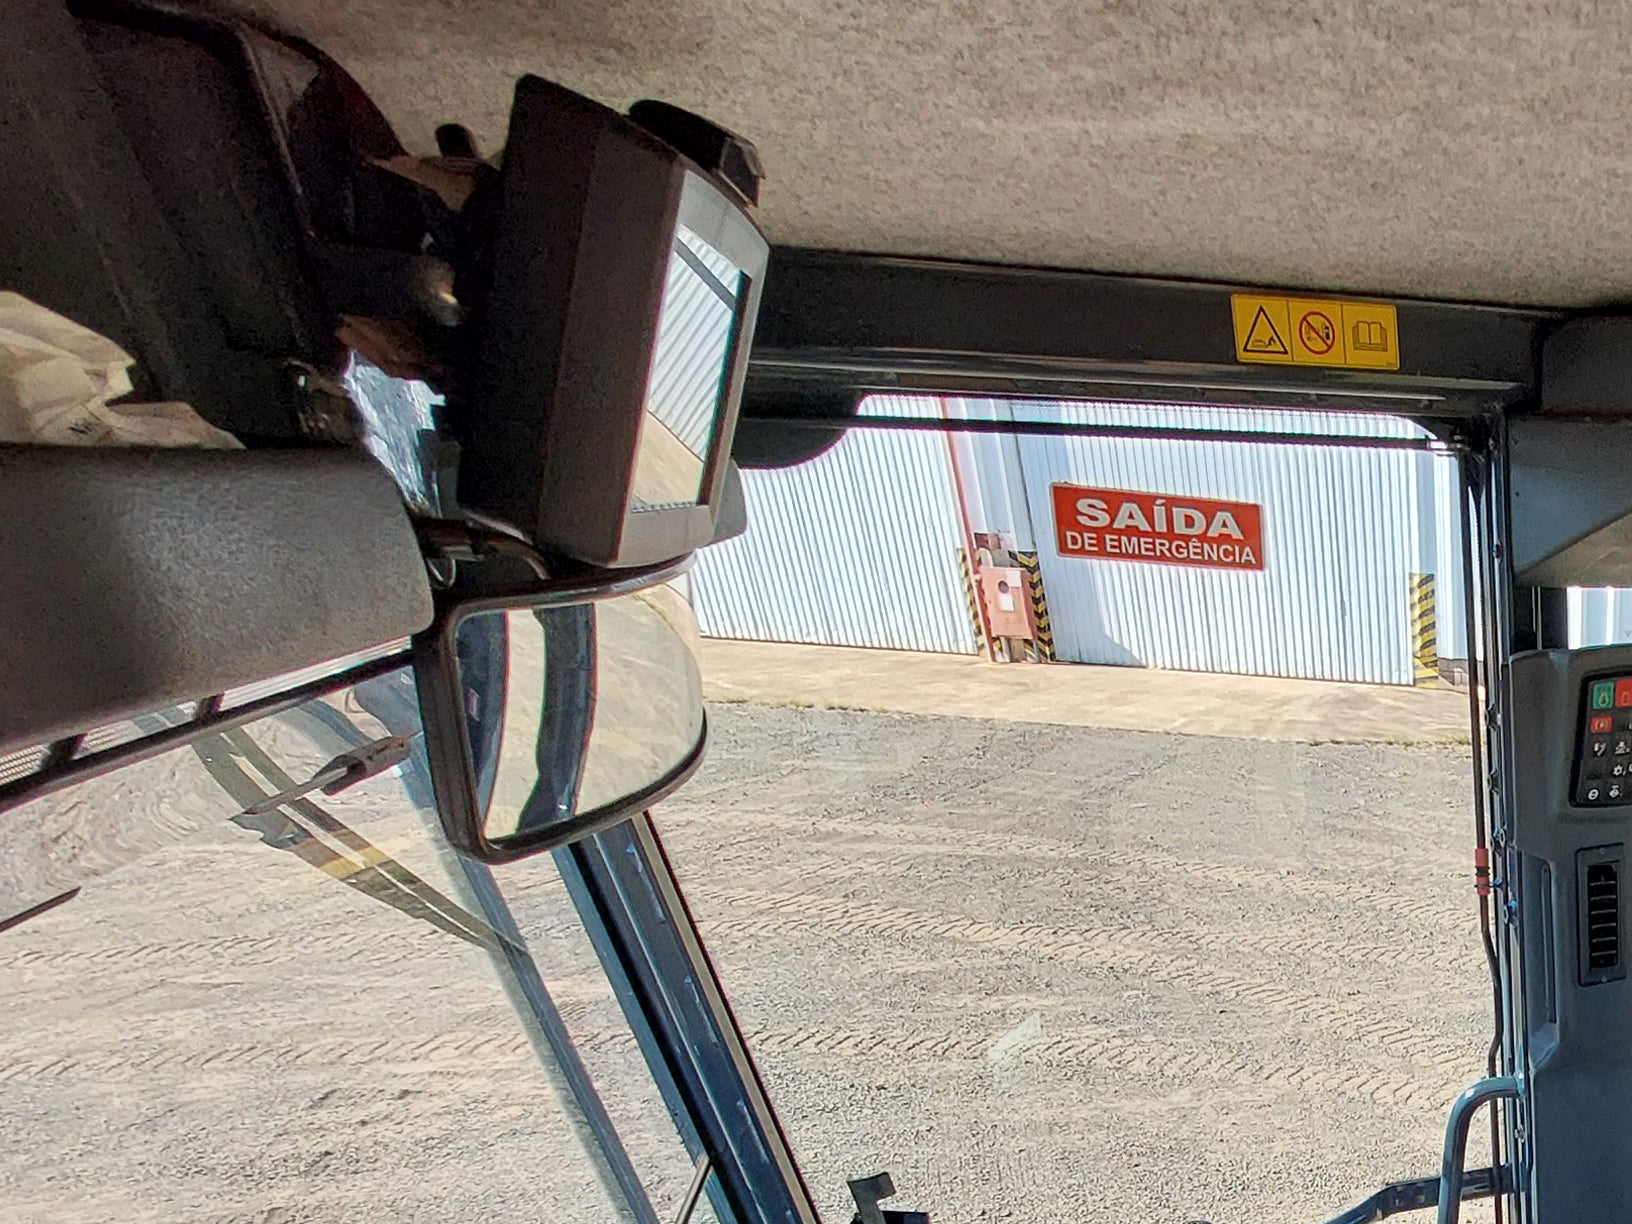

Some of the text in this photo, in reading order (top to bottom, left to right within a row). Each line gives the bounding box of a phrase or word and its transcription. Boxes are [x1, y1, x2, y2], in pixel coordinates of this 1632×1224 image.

[1075, 498, 1244, 540] SAÍDA
[1066, 530, 1256, 564] DE EMERGÊNCIA
